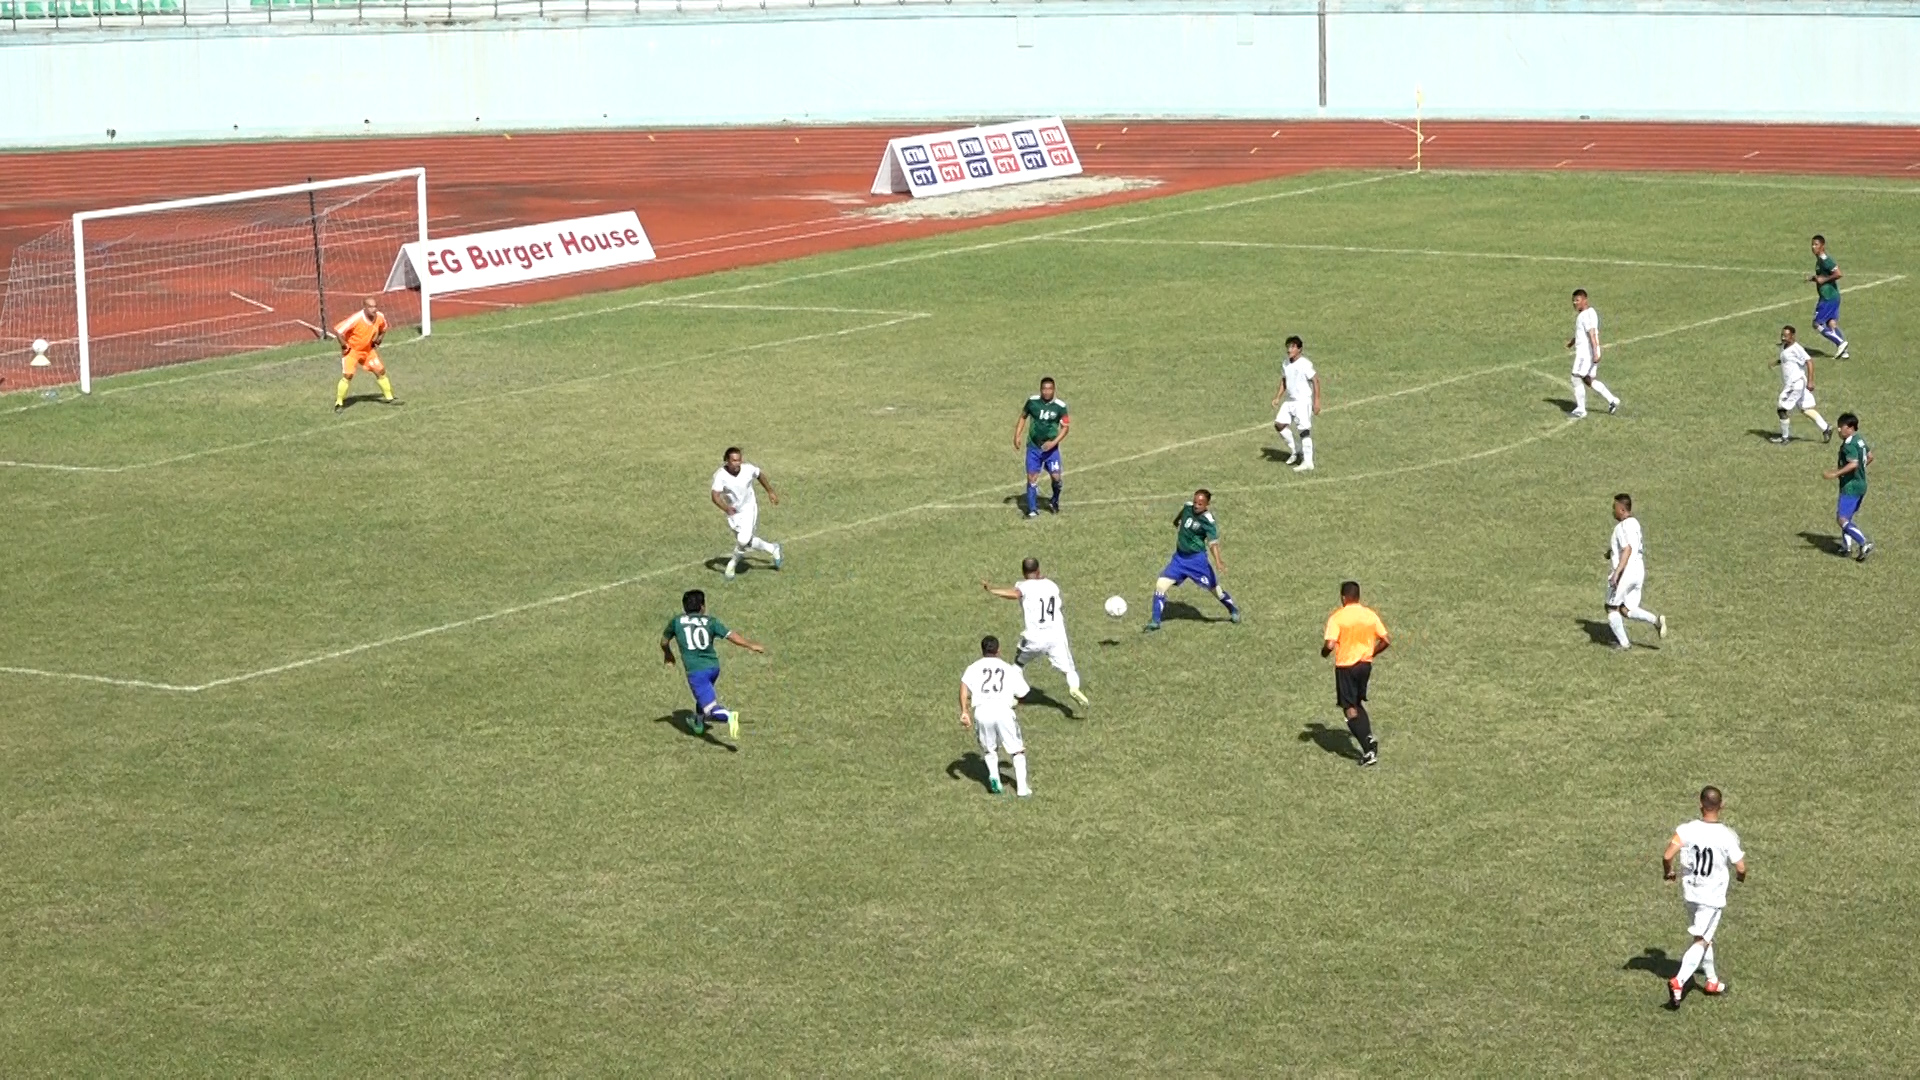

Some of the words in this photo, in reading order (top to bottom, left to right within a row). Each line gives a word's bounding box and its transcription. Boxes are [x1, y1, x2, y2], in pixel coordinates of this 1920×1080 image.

[466, 240, 554, 270] Burger
[558, 228, 640, 256] House
[1039, 596, 1056, 623] 14
[683, 626, 710, 651] 10
[981, 667, 1005, 694] 23
[1692, 844, 1714, 877] 10
